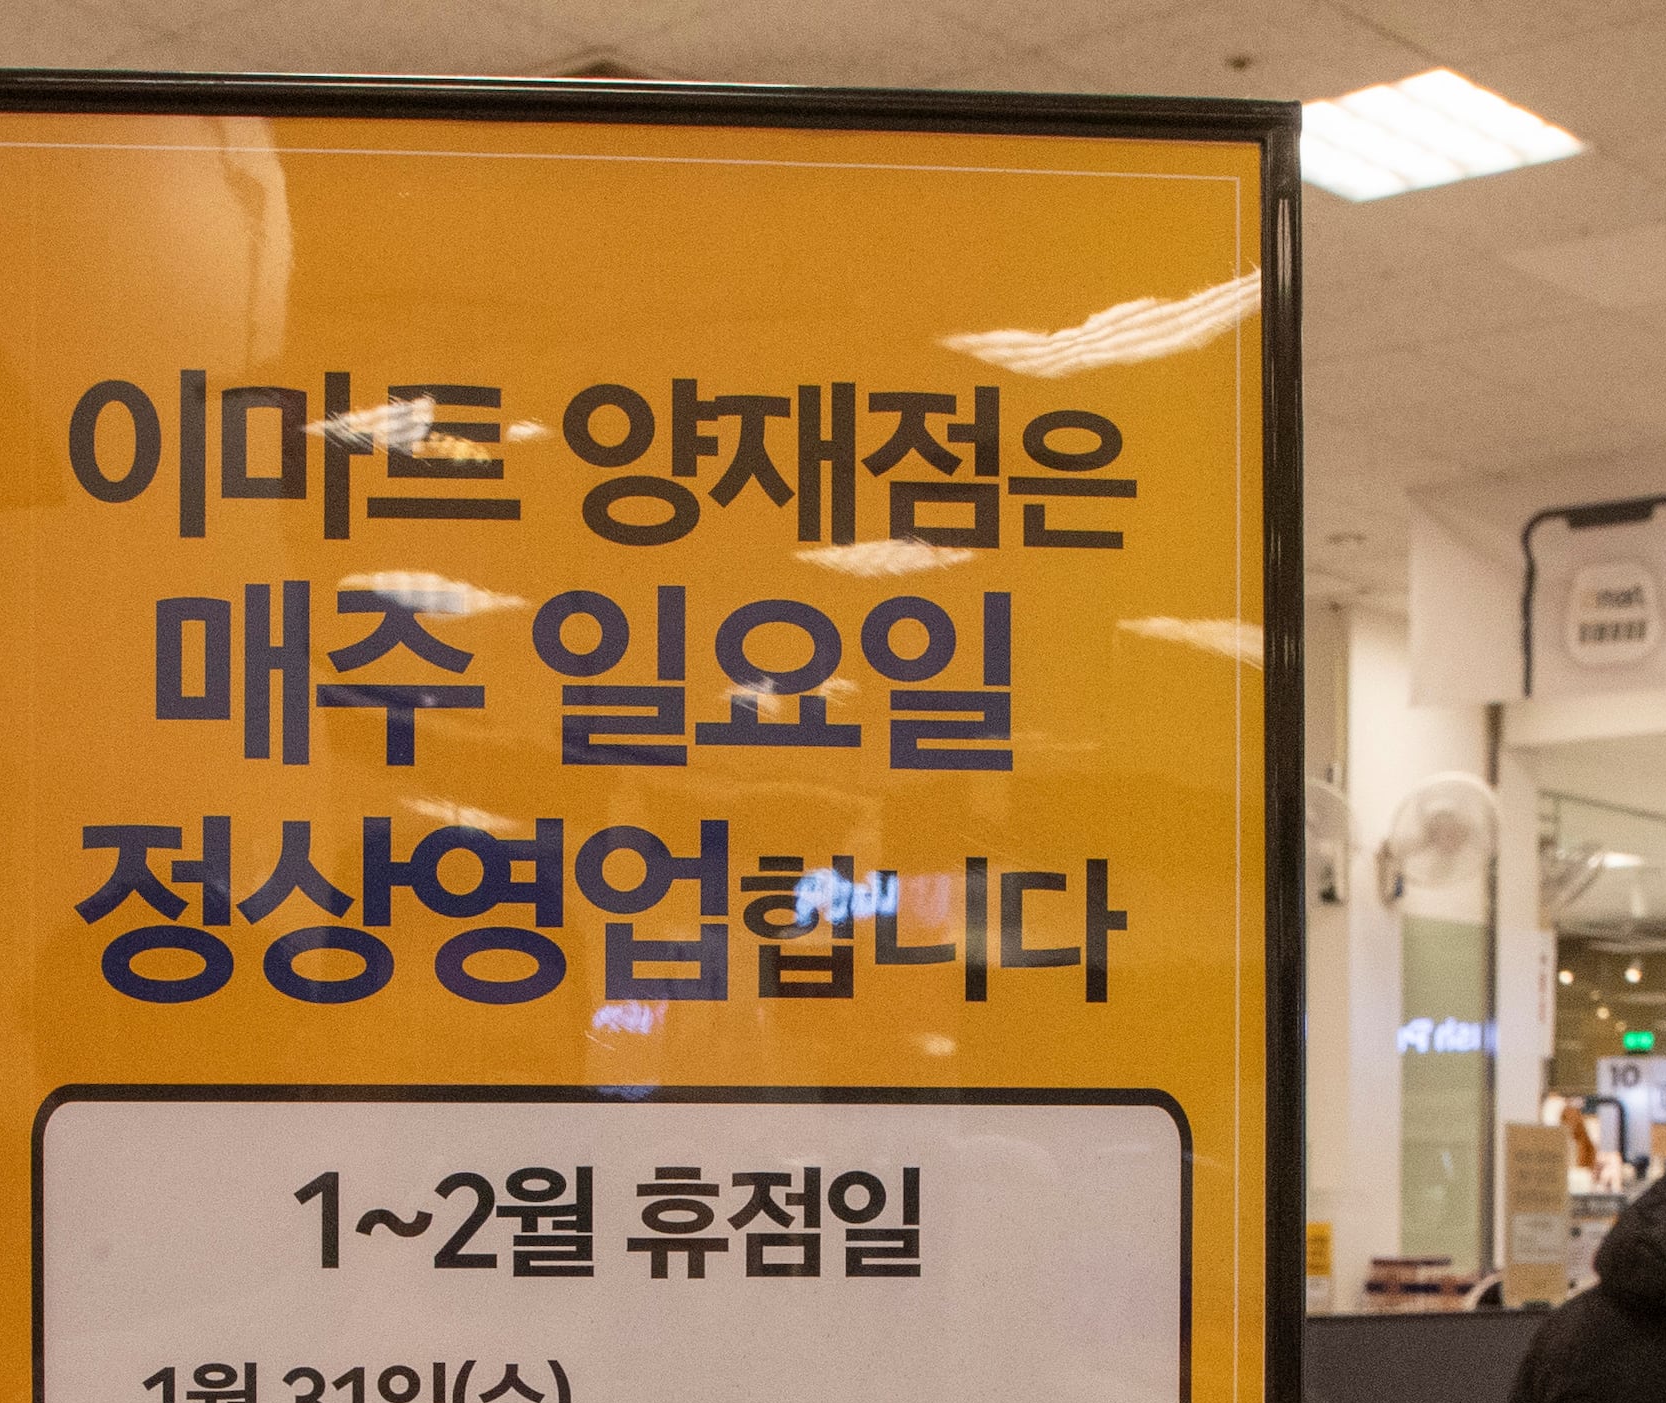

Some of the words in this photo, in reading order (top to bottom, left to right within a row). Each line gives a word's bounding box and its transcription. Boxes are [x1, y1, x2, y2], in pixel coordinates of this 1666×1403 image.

[69, 370, 521, 540] 이마트
[563, 379, 1136, 549] 양재점은
[156, 581, 485, 767] 매주
[533, 586, 1013, 771] 일요일
[76, 817, 1126, 1004] 정상영업합니다
[296, 1167, 594, 1277] 1~2월
[627, 1167, 920, 1278] 휴점일
